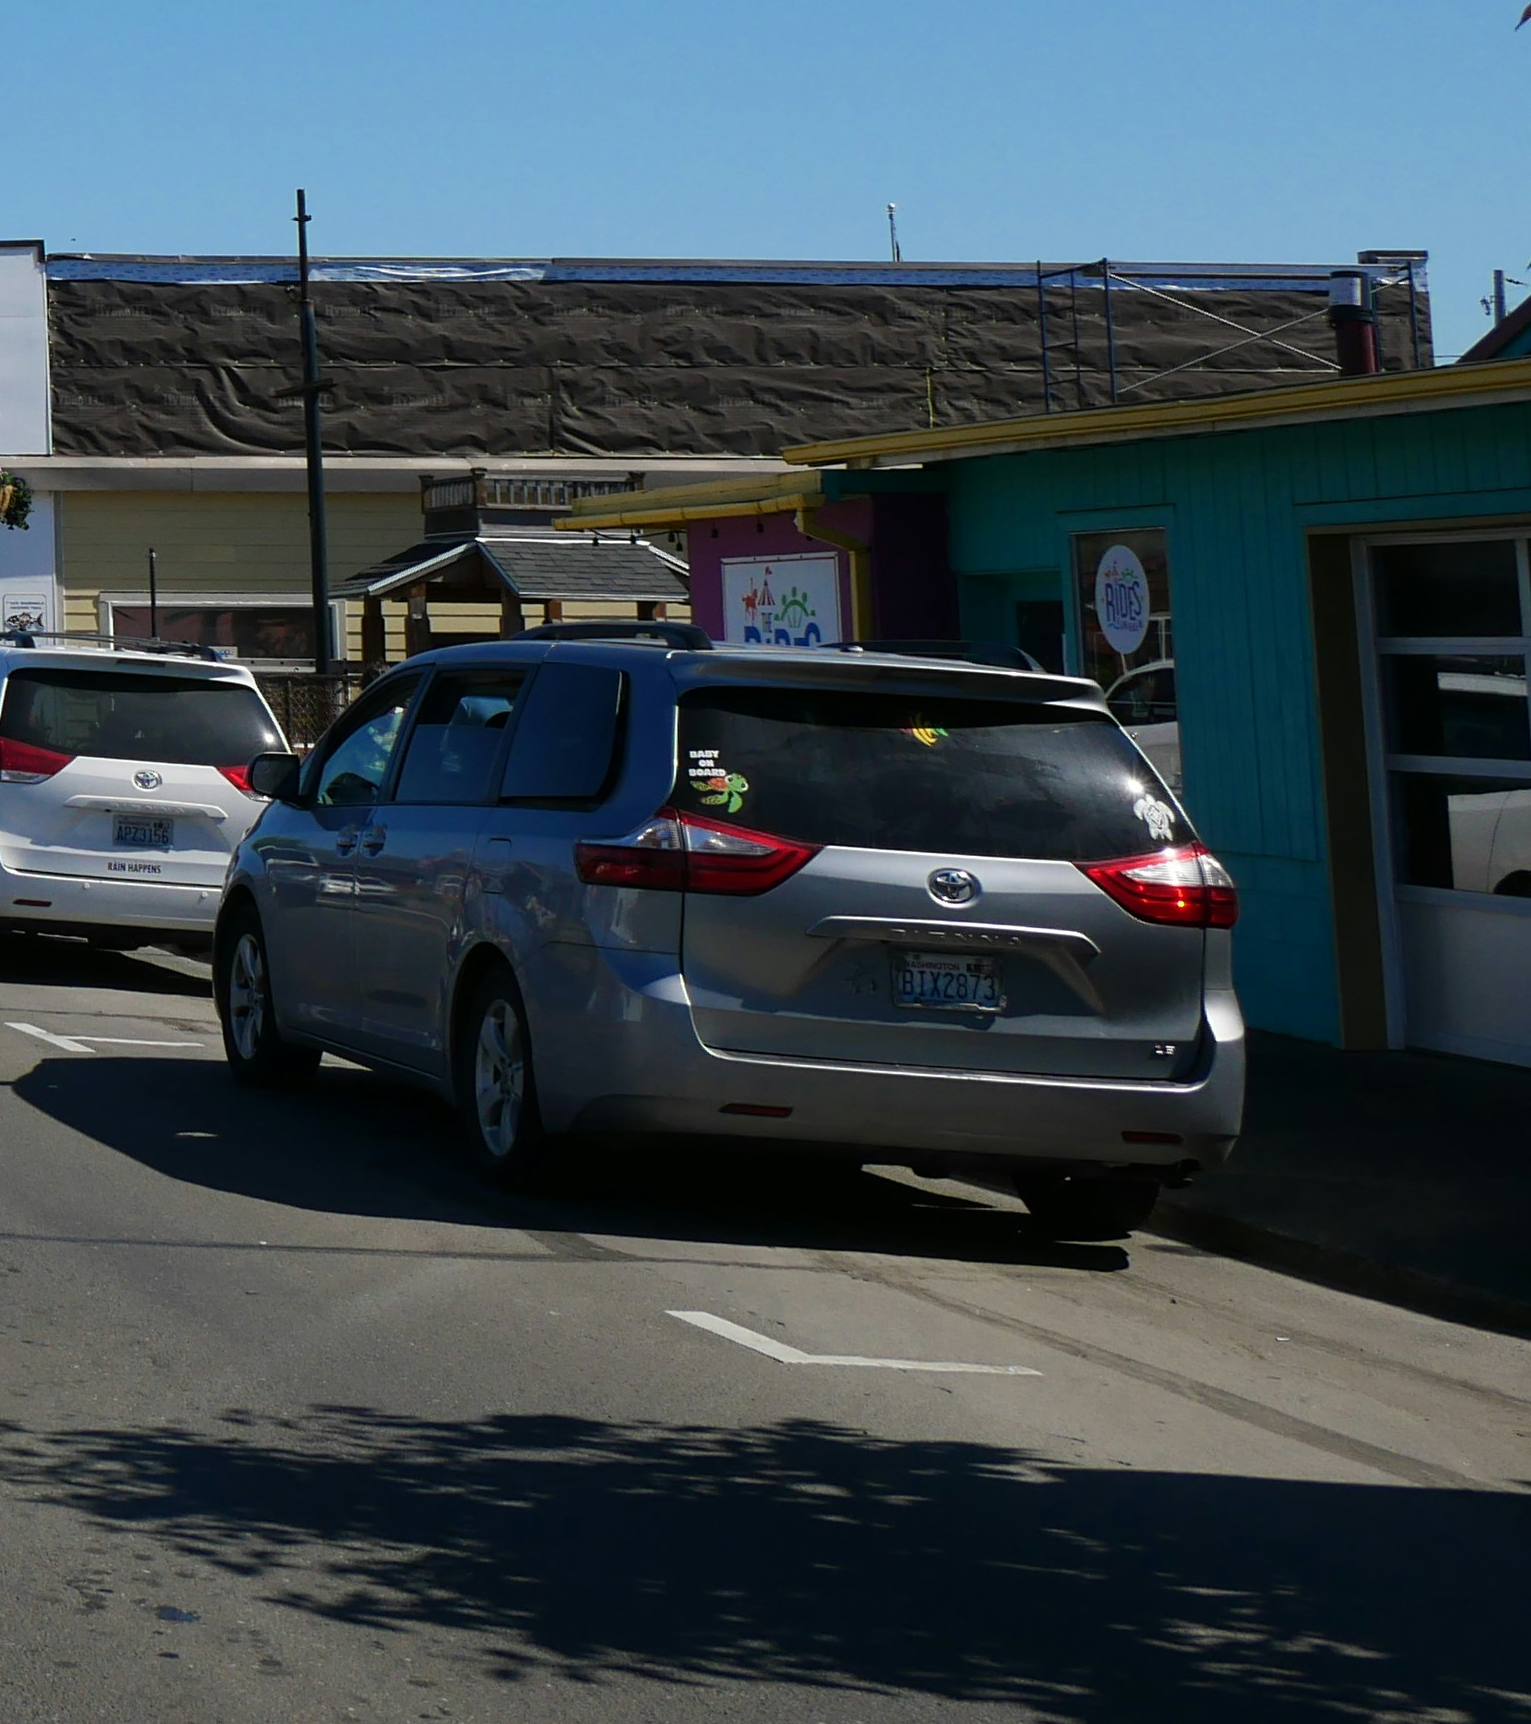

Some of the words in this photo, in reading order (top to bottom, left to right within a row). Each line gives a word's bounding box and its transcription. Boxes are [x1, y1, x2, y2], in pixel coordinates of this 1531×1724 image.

[689, 750, 719, 758] BABY
[699, 759, 714, 767] ON
[689, 769, 726, 777] BOARD
[117, 826, 169, 844] APZ3156
[107, 862, 127, 872] RAIN
[128, 863, 161, 874] HAPPENS
[902, 969, 997, 1001] BIX2873
